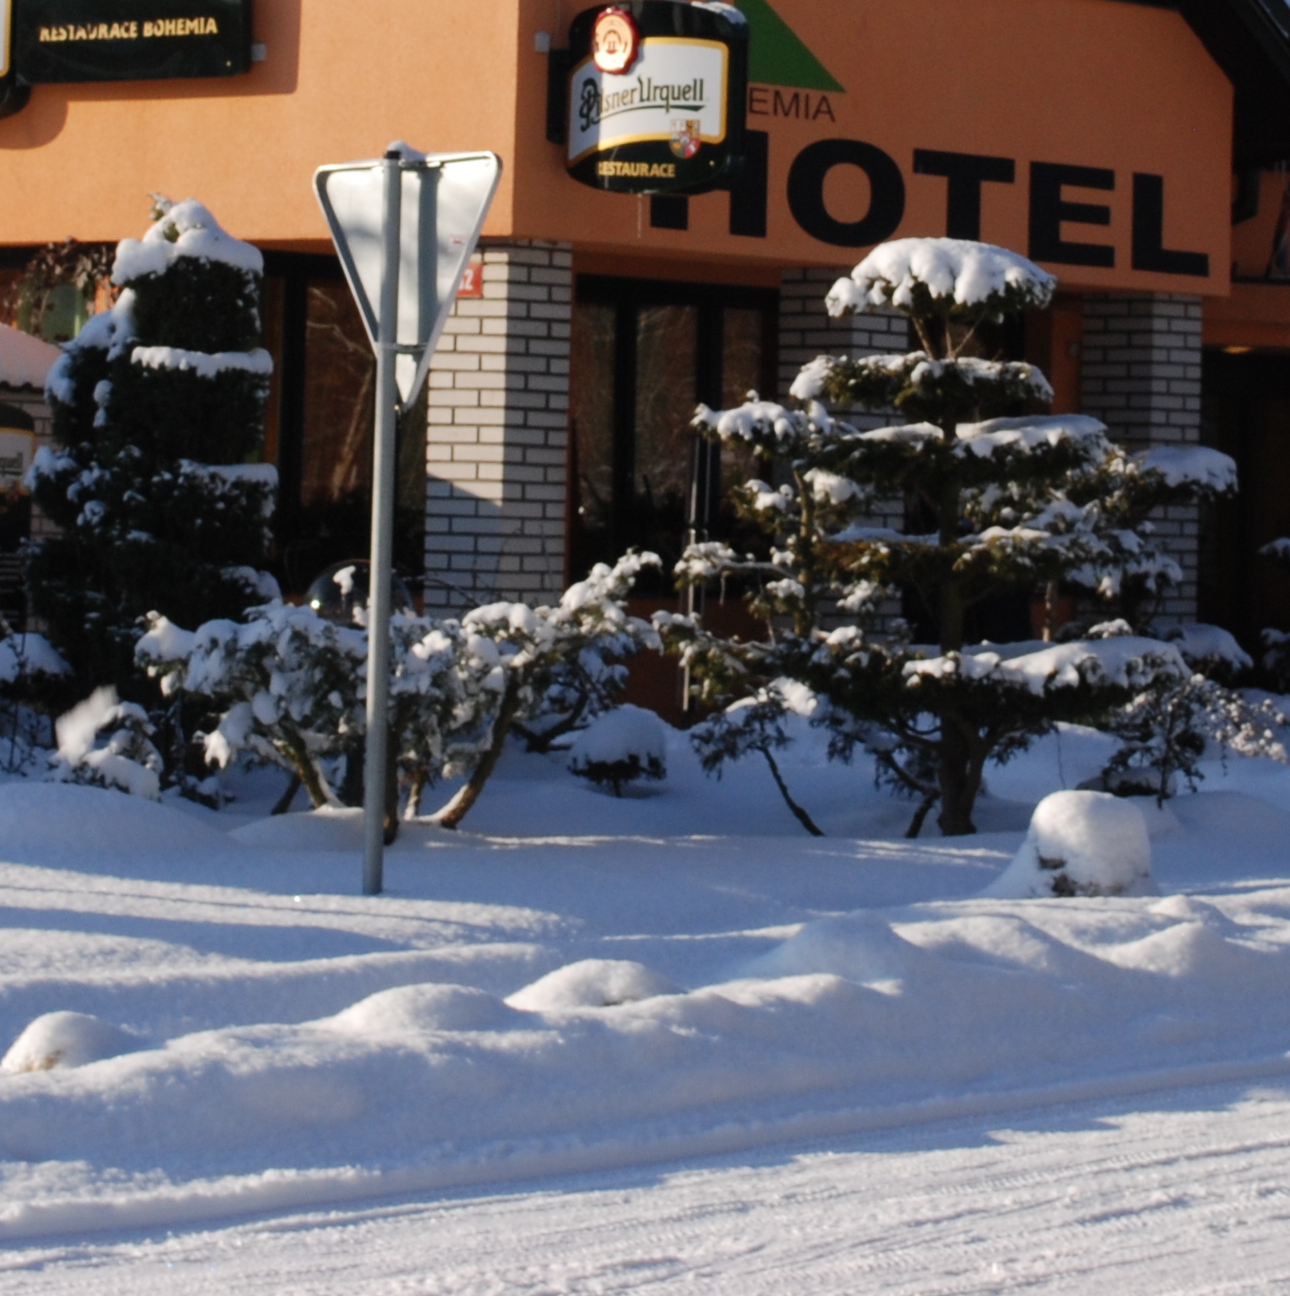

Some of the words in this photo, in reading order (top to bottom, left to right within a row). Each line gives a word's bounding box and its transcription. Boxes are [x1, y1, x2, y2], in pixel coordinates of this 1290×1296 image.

[39, 21, 139, 42] RESTAURACE
[142, 16, 219, 38] BOHEMIA
[637, 75, 704, 114] Urquell
[748, 86, 836, 123] EMIA
[597, 160, 676, 178] RESTAURACE
